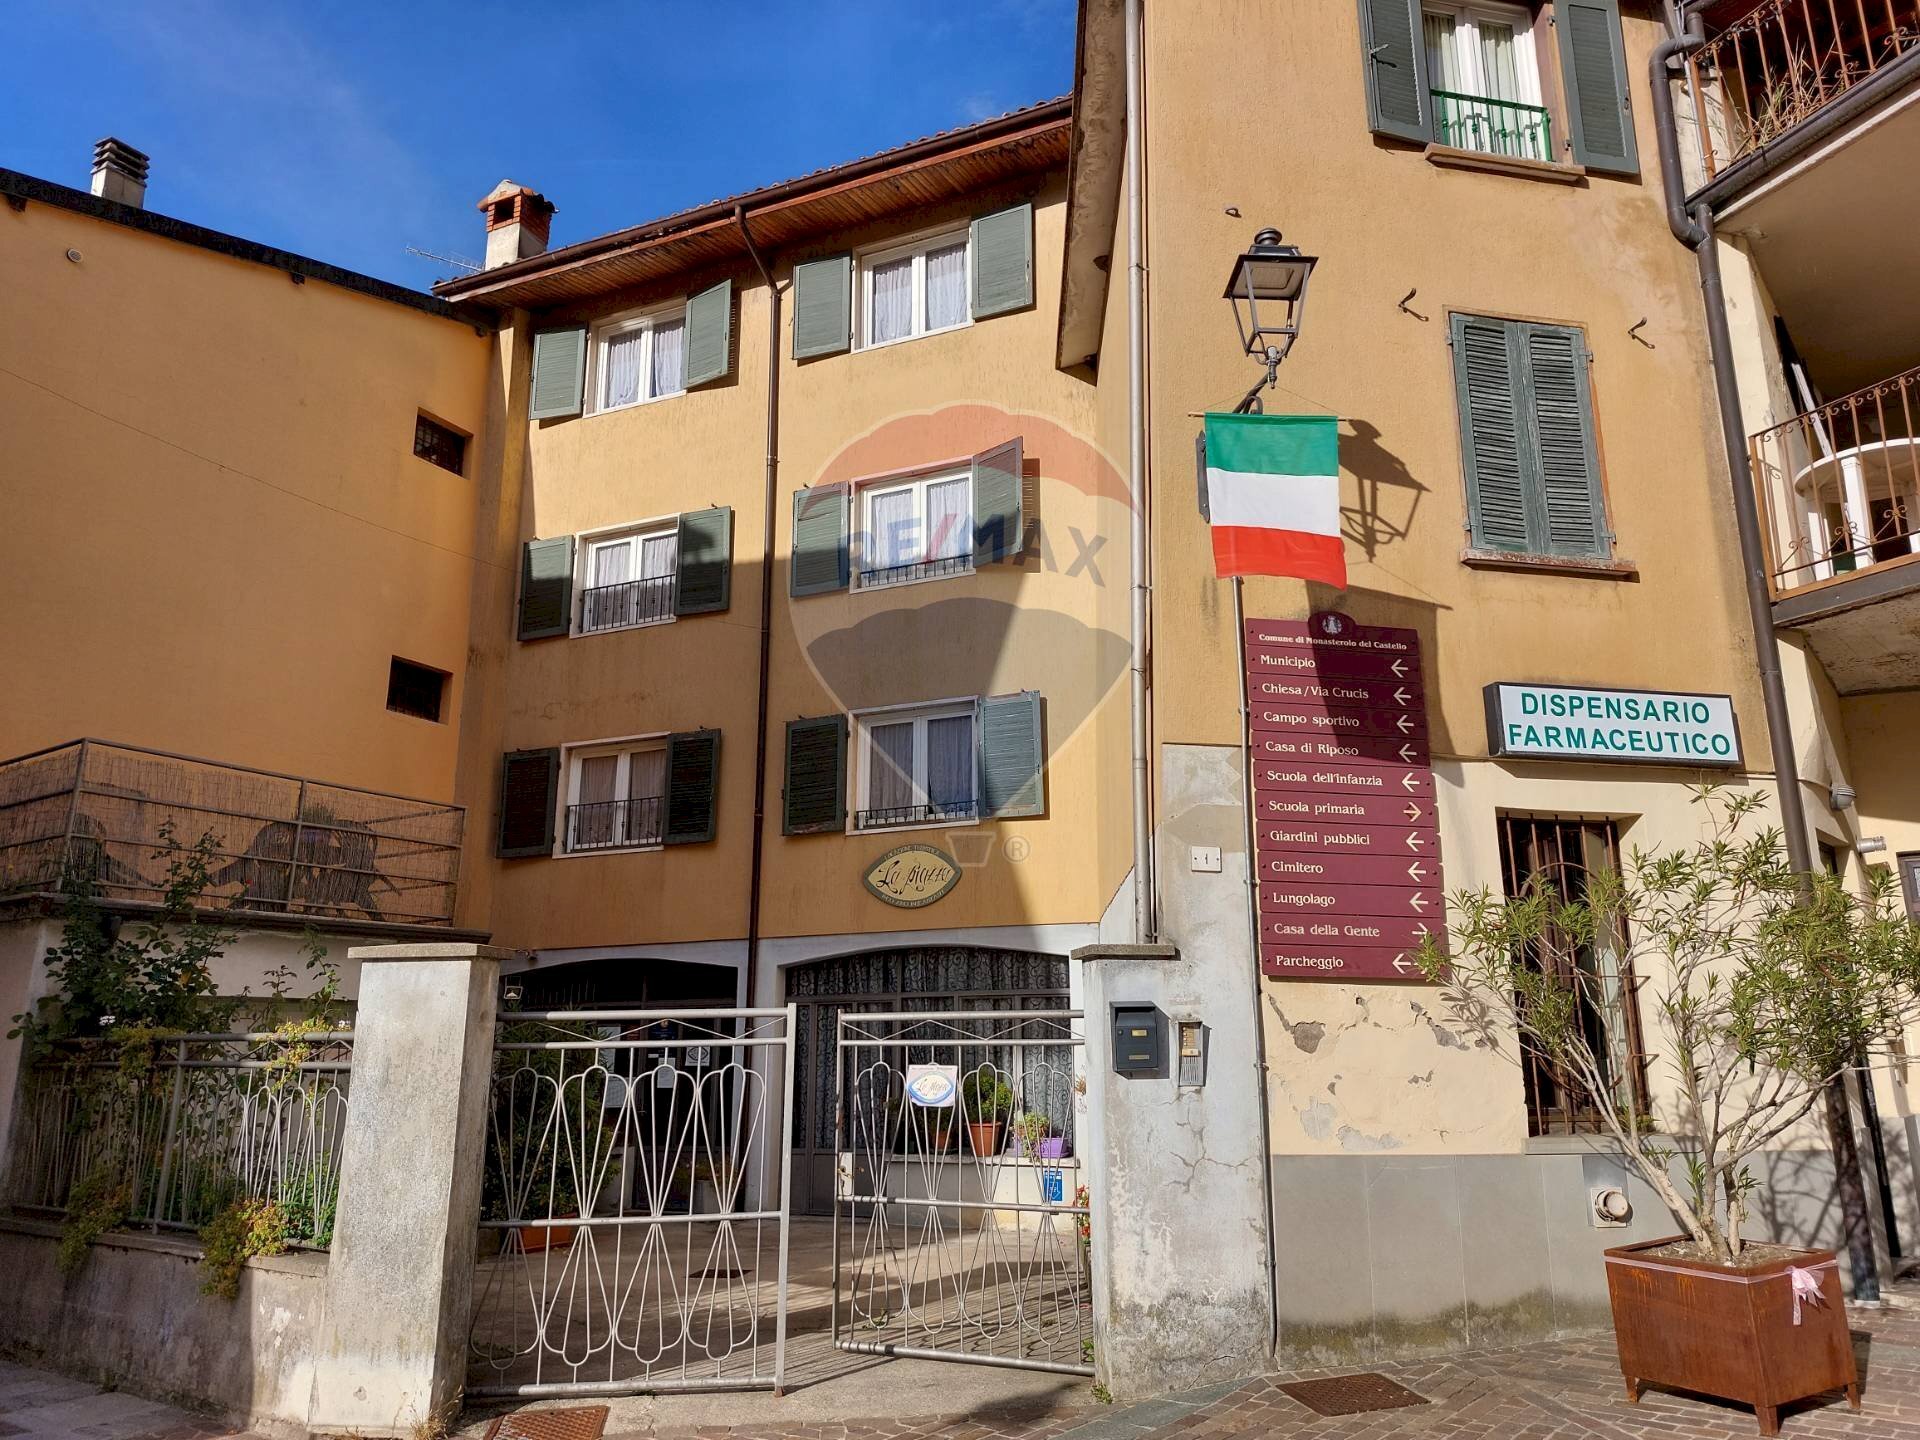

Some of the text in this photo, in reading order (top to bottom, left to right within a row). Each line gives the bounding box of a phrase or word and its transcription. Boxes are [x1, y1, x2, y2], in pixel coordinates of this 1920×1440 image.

[1259, 634, 1294, 643] Comune
[1306, 637, 1357, 647] Monasterolo
[1373, 642, 1407, 650] Castello
[1261, 655, 1316, 668] Municipio
[1333, 688, 1369, 698] Crucis
[1521, 692, 1710, 724] DISPENSARIO
[1264, 712, 1360, 727] Campo sportivo
[1509, 723, 1731, 756] FARMACEUTICO
[1266, 741, 1359, 756] Casa di Riposo
[1267, 771, 1383, 786] Scuola dell'infanzia
[1269, 801, 1365, 815] Scuola primaria
[1270, 831, 1370, 845] Giardini pubblici
[1272, 861, 1323, 873] Cimitero
[1273, 892, 1335, 906] Lungolago
[1274, 923, 1380, 936] Casa della Gente
[1276, 955, 1344, 969] Parcheggio
